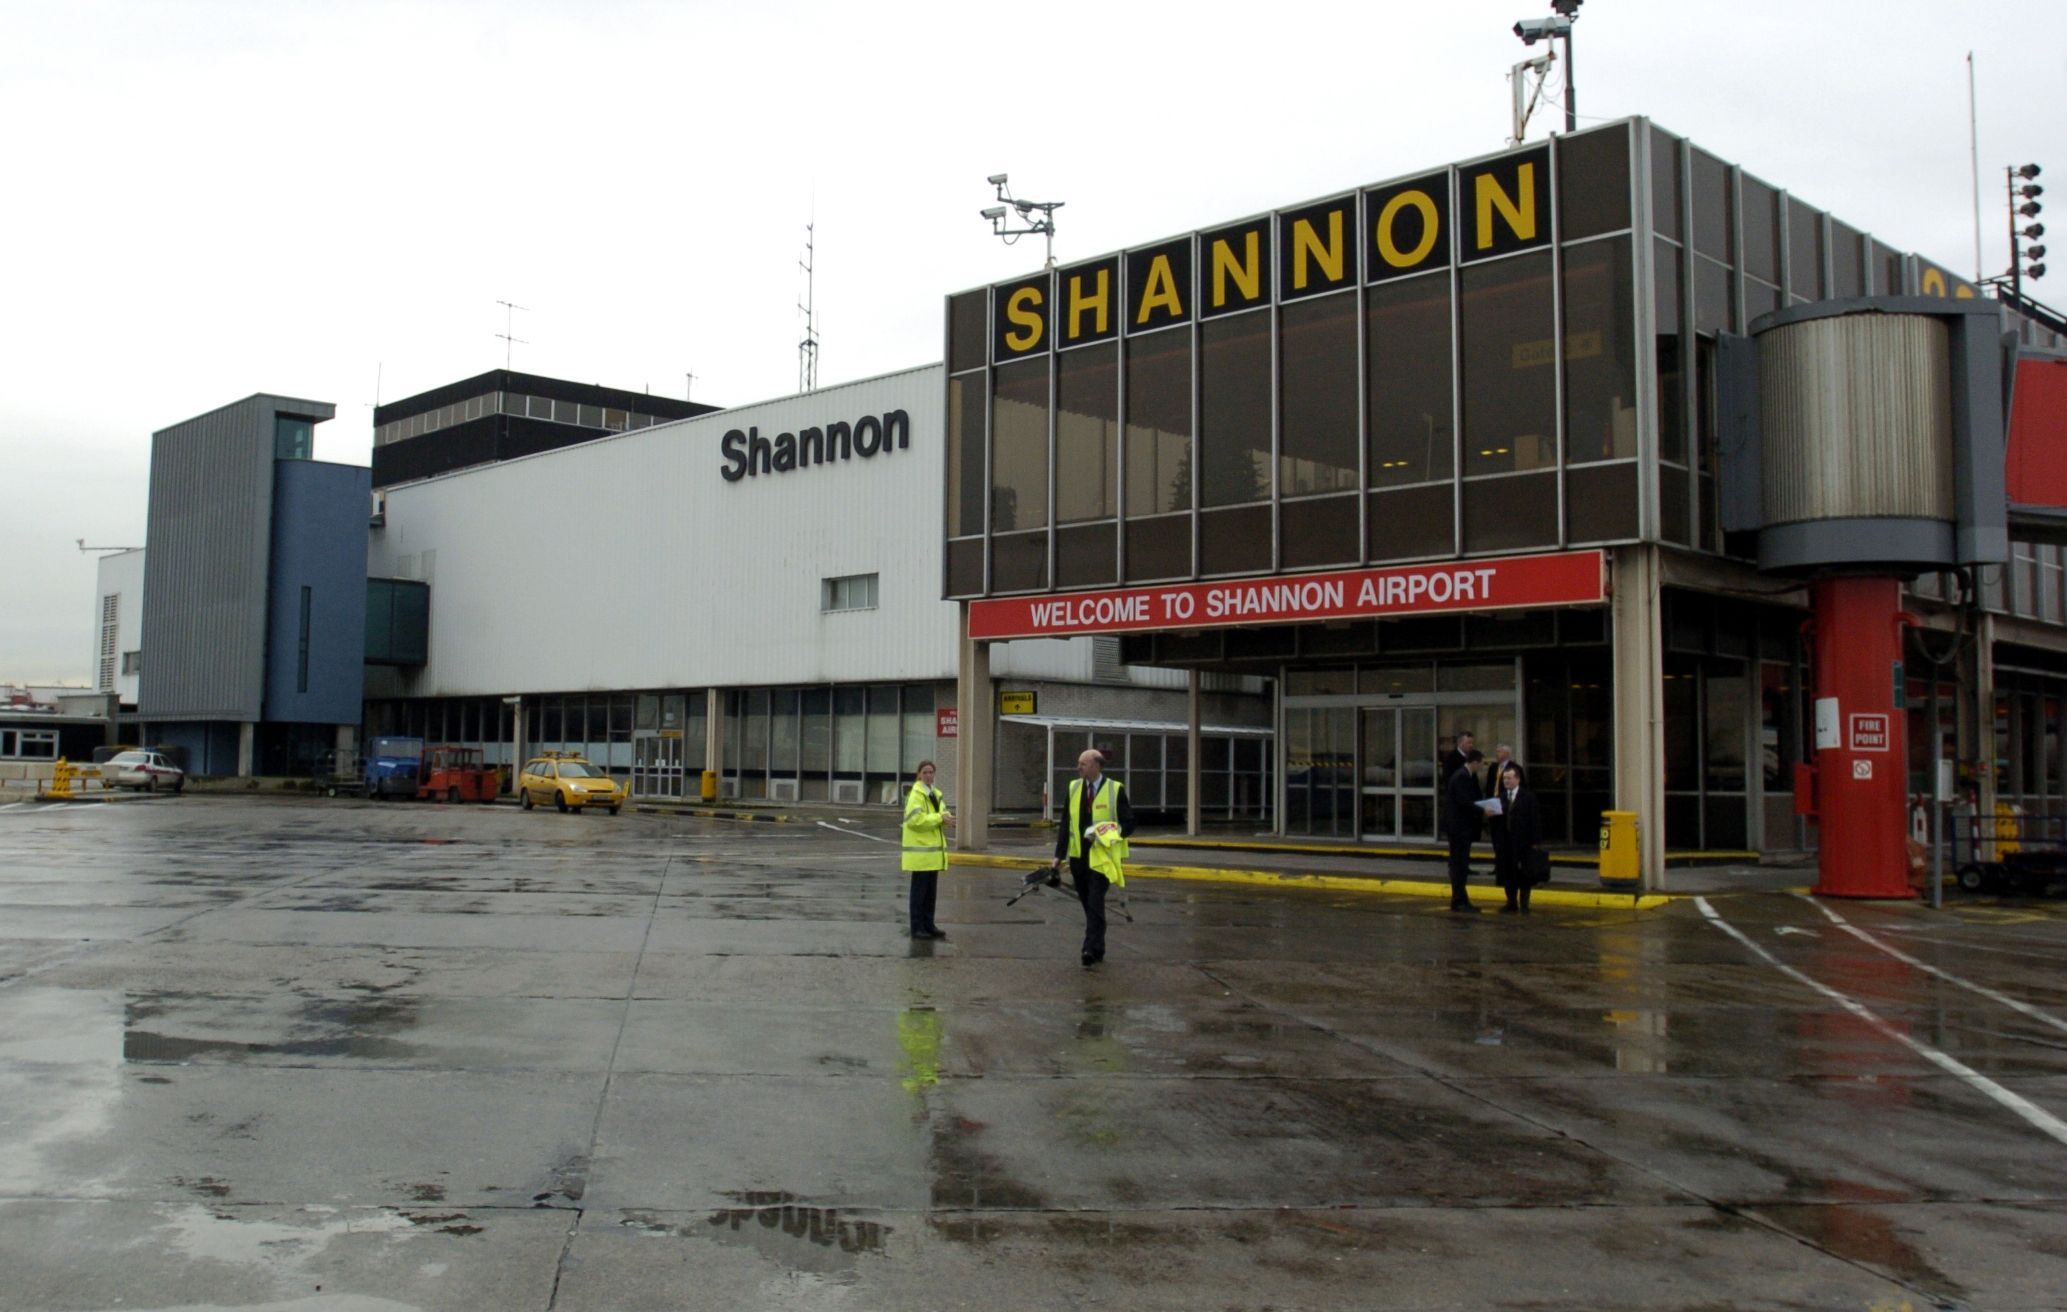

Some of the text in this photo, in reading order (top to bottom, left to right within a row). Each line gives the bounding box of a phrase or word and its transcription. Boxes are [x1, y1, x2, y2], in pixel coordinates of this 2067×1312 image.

[1005, 162, 1537, 352] SHANNON
[721, 408, 910, 484] Shannon
[1030, 569, 1496, 628] WELCOME TO SHANNON AIRPORT
[1855, 733, 1884, 745] POINT
[1858, 719, 1881, 731] FIRE
